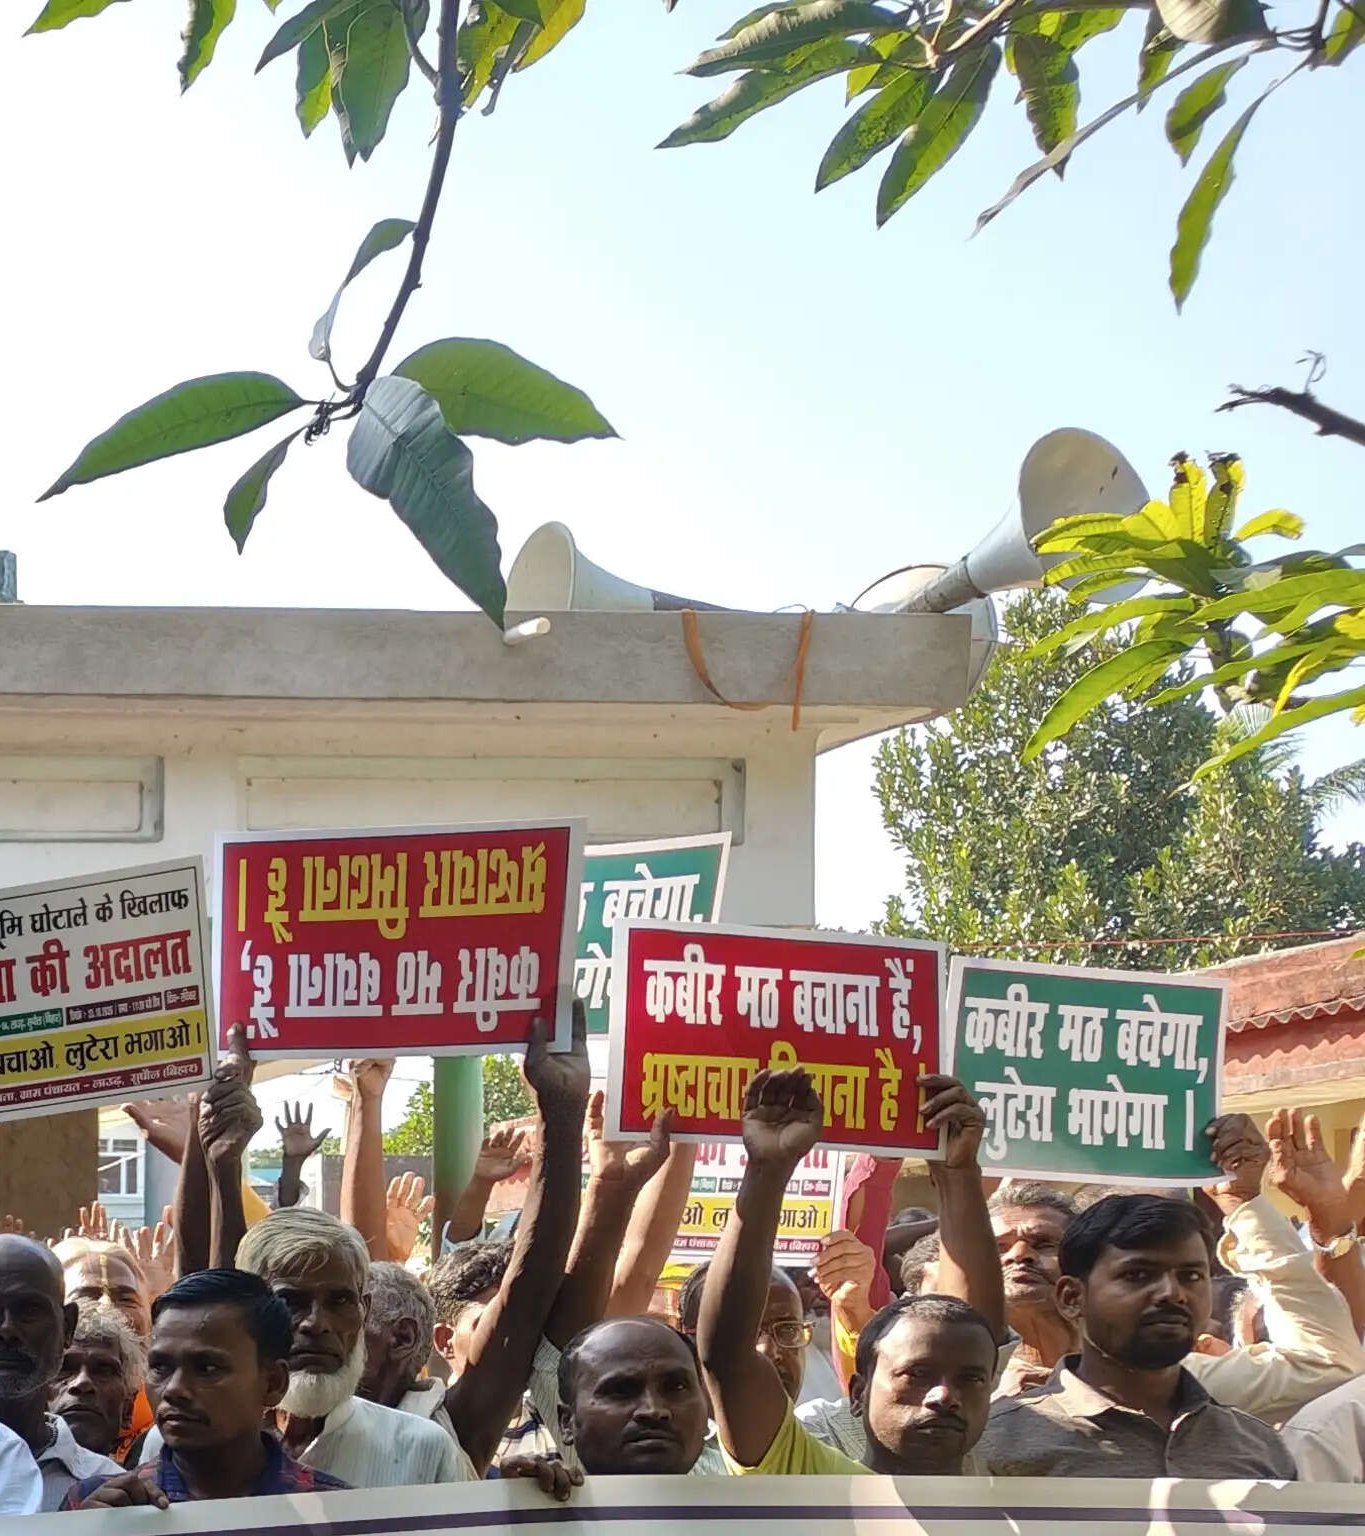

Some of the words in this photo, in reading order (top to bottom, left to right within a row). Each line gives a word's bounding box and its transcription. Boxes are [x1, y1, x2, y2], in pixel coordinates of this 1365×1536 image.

[29, 897, 88, 933] घोटाले
[95, 893, 113, 922] के
[119, 888, 189, 919] खिलाफ
[263, 857, 294, 945] है
[299, 852, 410, 940] मिटाना
[419, 841, 547, 919] भ्रष्टाचार
[25, 938, 70, 997] की
[84, 929, 192, 990] अदालत
[284, 951, 384, 1018] बचाना
[391, 950, 444, 1016] मठ
[453, 945, 541, 1032] कबीर
[644, 943, 726, 1025] कबीर
[735, 966, 783, 1029] मठ
[789, 970, 880, 1037] बचाना
[65, 1034, 118, 1070] लुटेरा
[125, 1018, 191, 1054] भगाओ
[965, 983, 1049, 1059] कबीर
[1058, 1004, 1108, 1062] मठ
[1116, 994, 1208, 1084] बचेगा,
[875, 1048, 902, 1132] है
[975, 1067, 1056, 1160] लुटेरा
[1068, 1074, 1168, 1150] भागेगा
